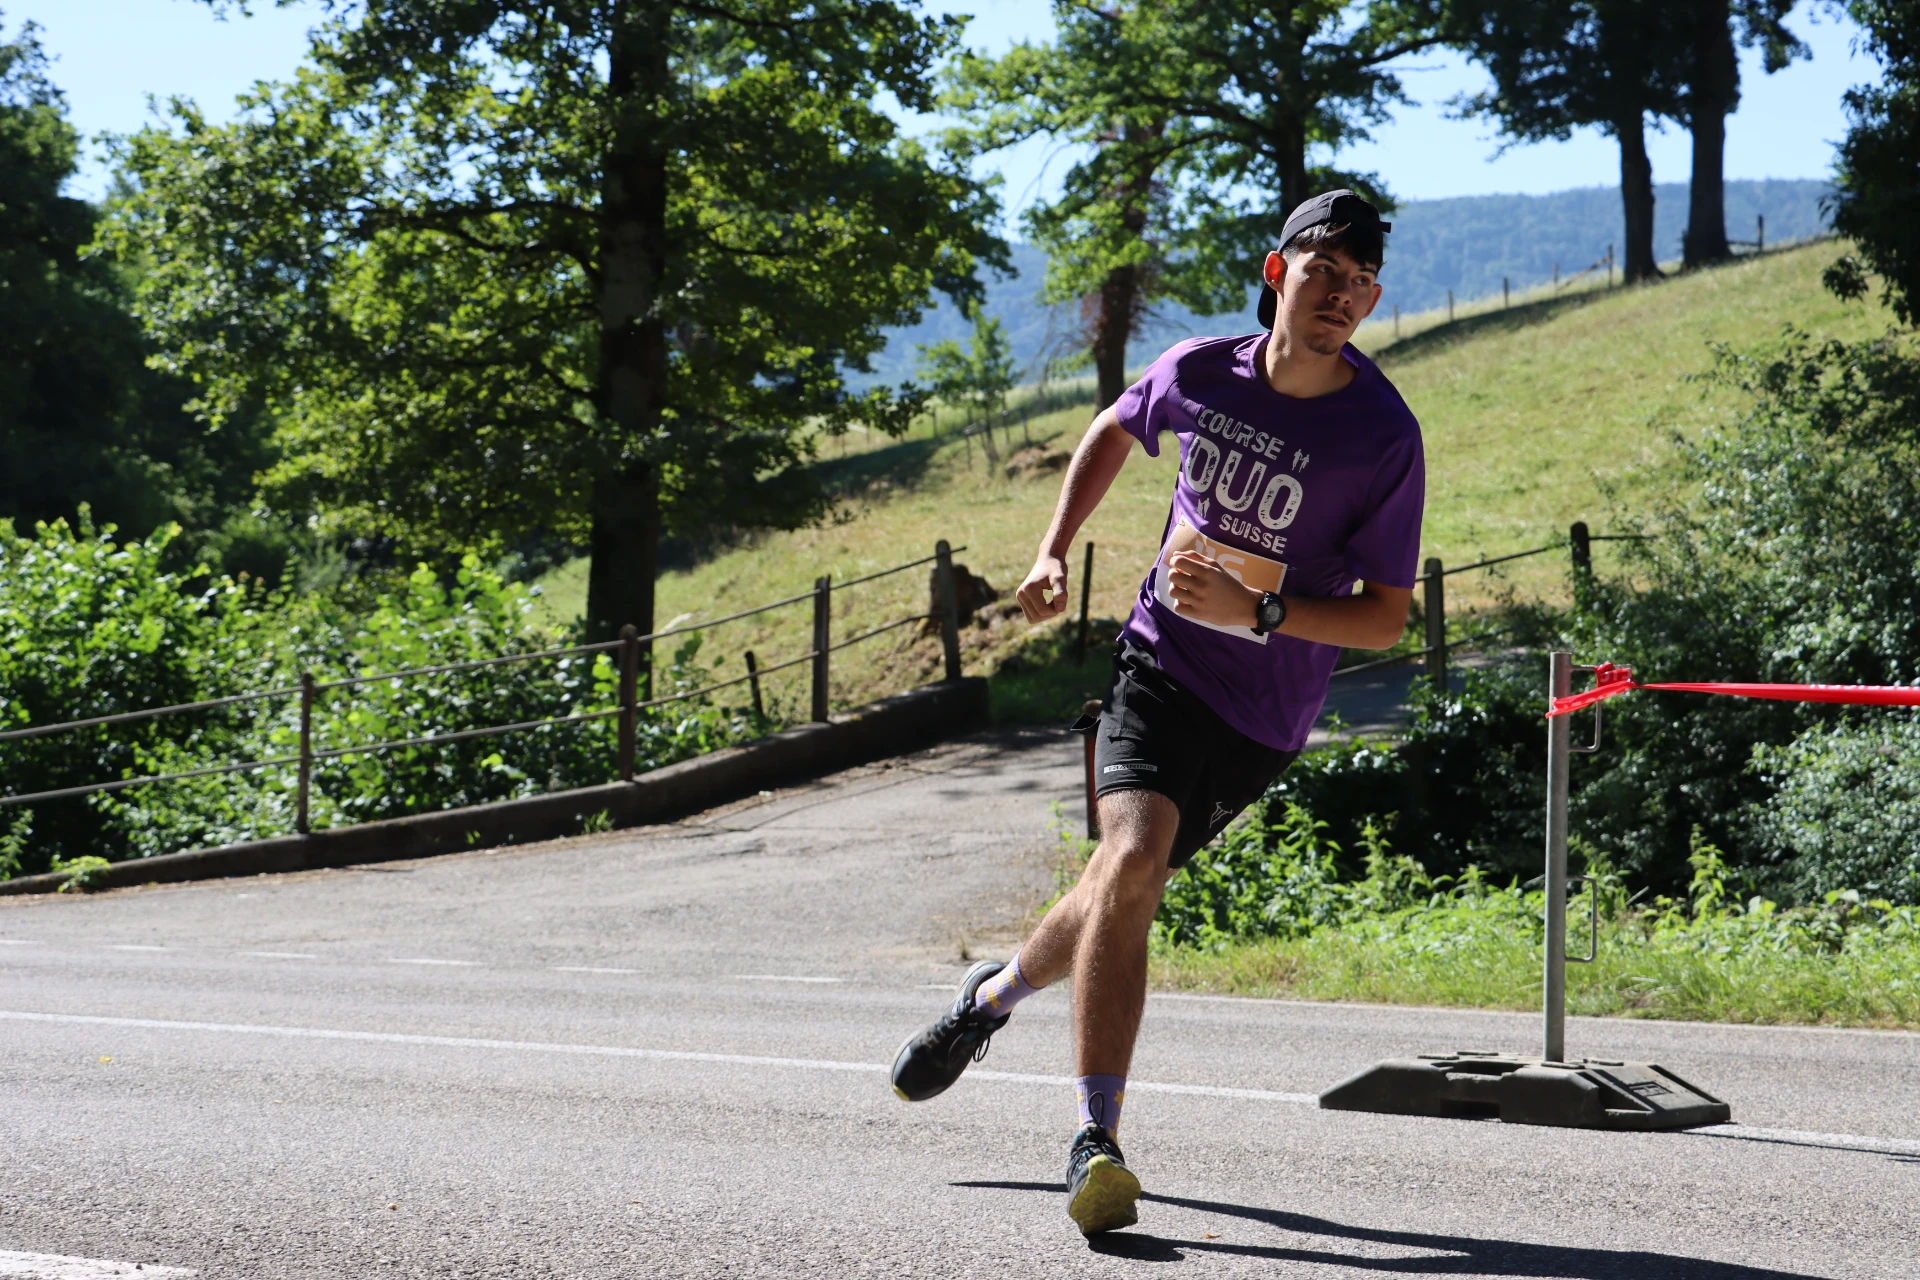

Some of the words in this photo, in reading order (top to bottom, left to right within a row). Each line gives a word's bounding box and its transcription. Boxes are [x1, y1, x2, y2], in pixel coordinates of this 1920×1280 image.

[1197, 408, 1285, 460] COURSE
[1185, 433, 1303, 530] DUO
[1219, 513, 1288, 554] SUISSE
